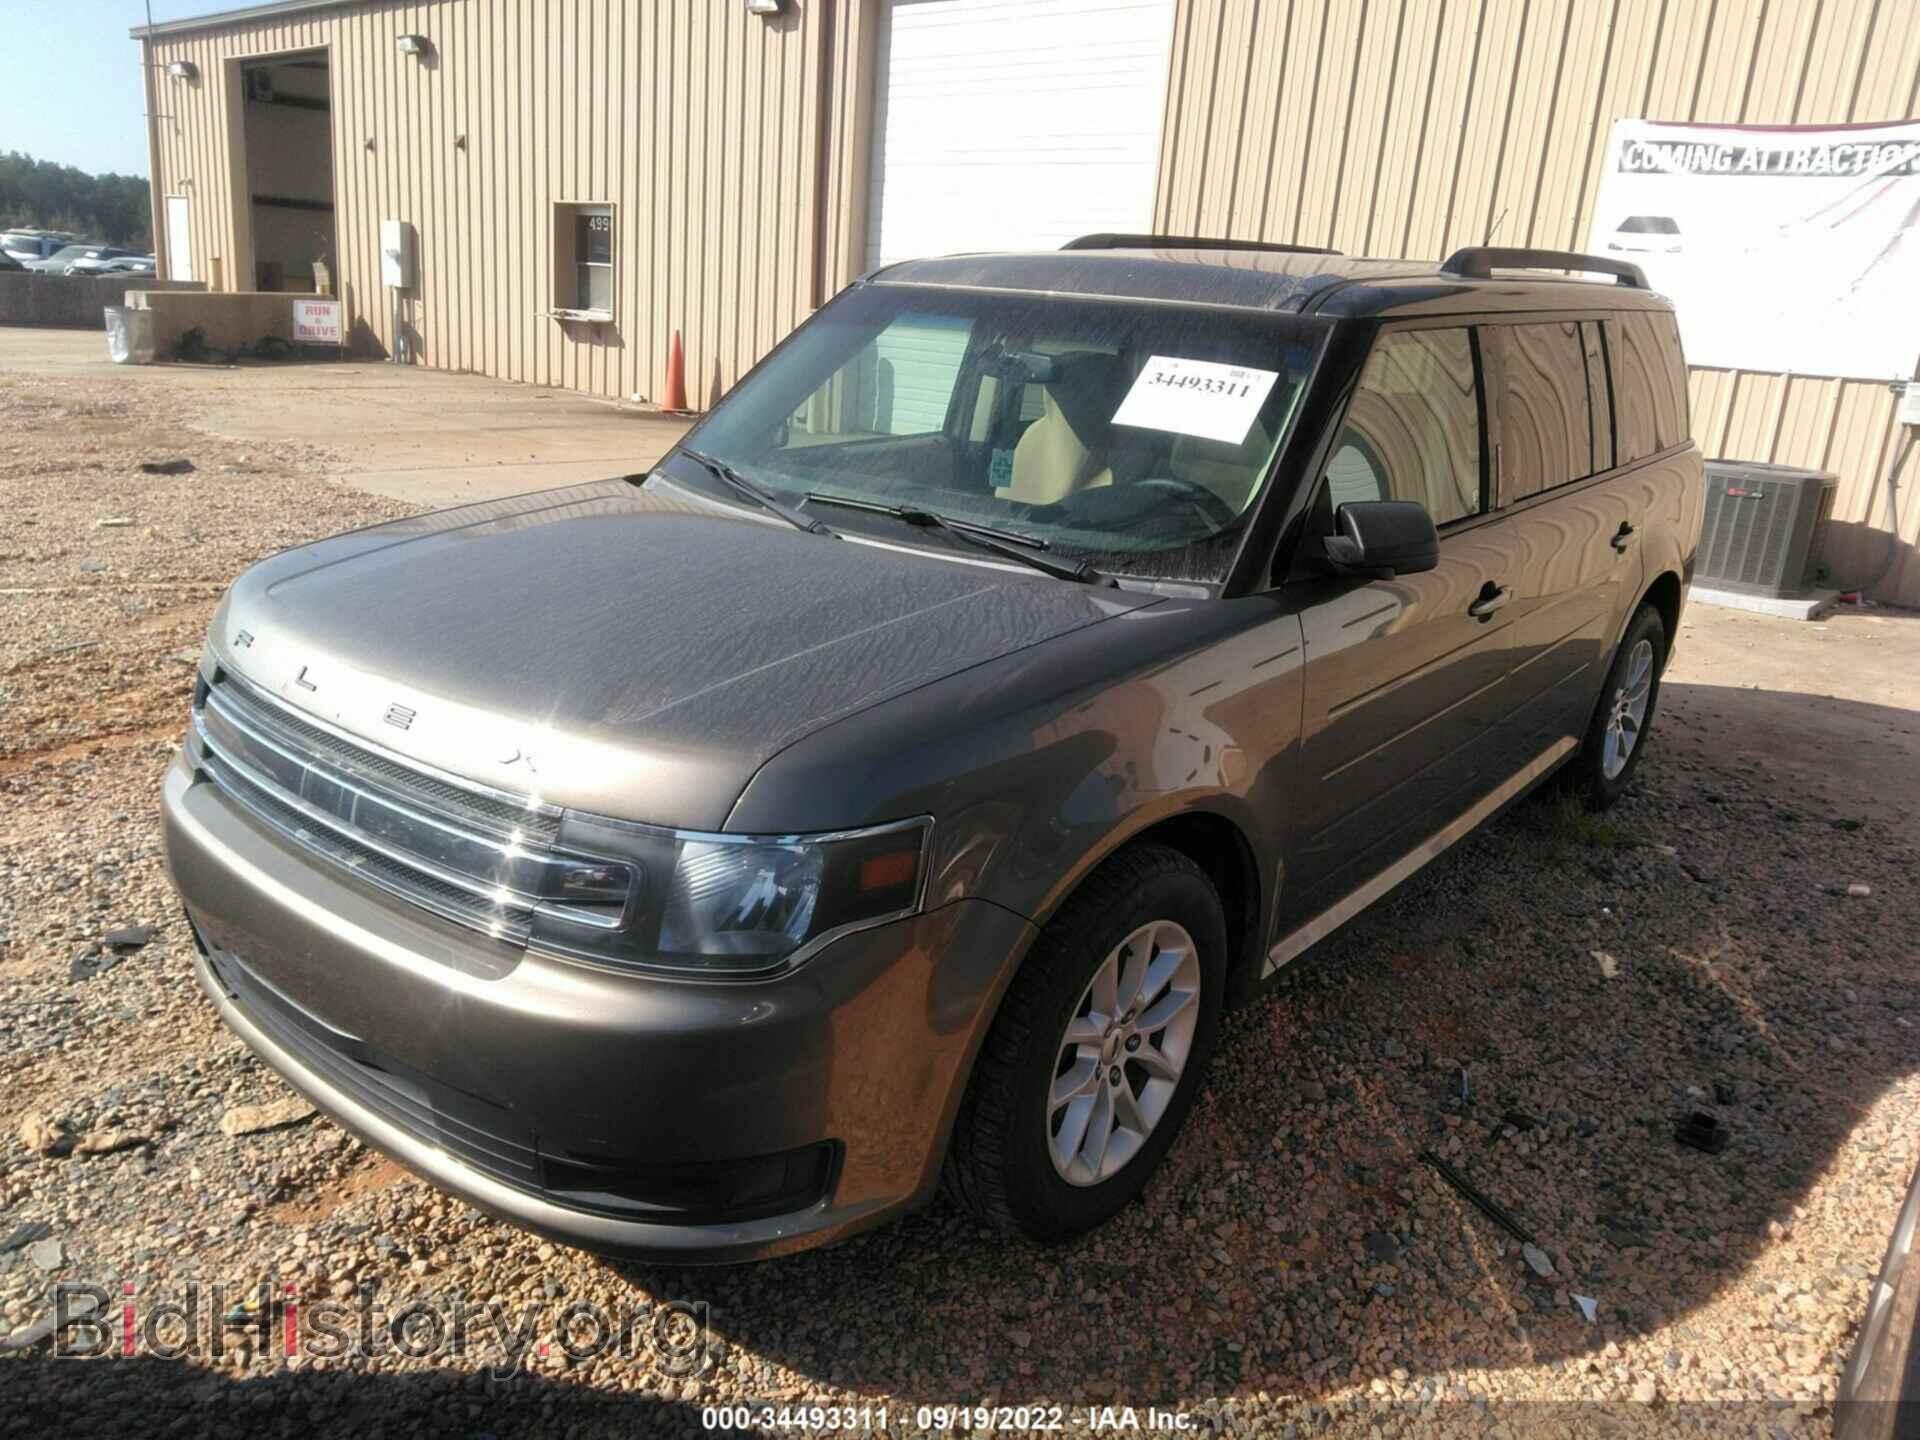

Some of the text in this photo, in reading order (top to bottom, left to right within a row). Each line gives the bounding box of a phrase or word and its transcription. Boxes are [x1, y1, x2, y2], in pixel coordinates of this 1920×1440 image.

[1622, 141, 1734, 175] COMING
[589, 215, 609, 231] 499
[305, 304, 331, 316] RUN
[299, 325, 337, 336] DRIVE
[1149, 372, 1250, 397] 34493311
